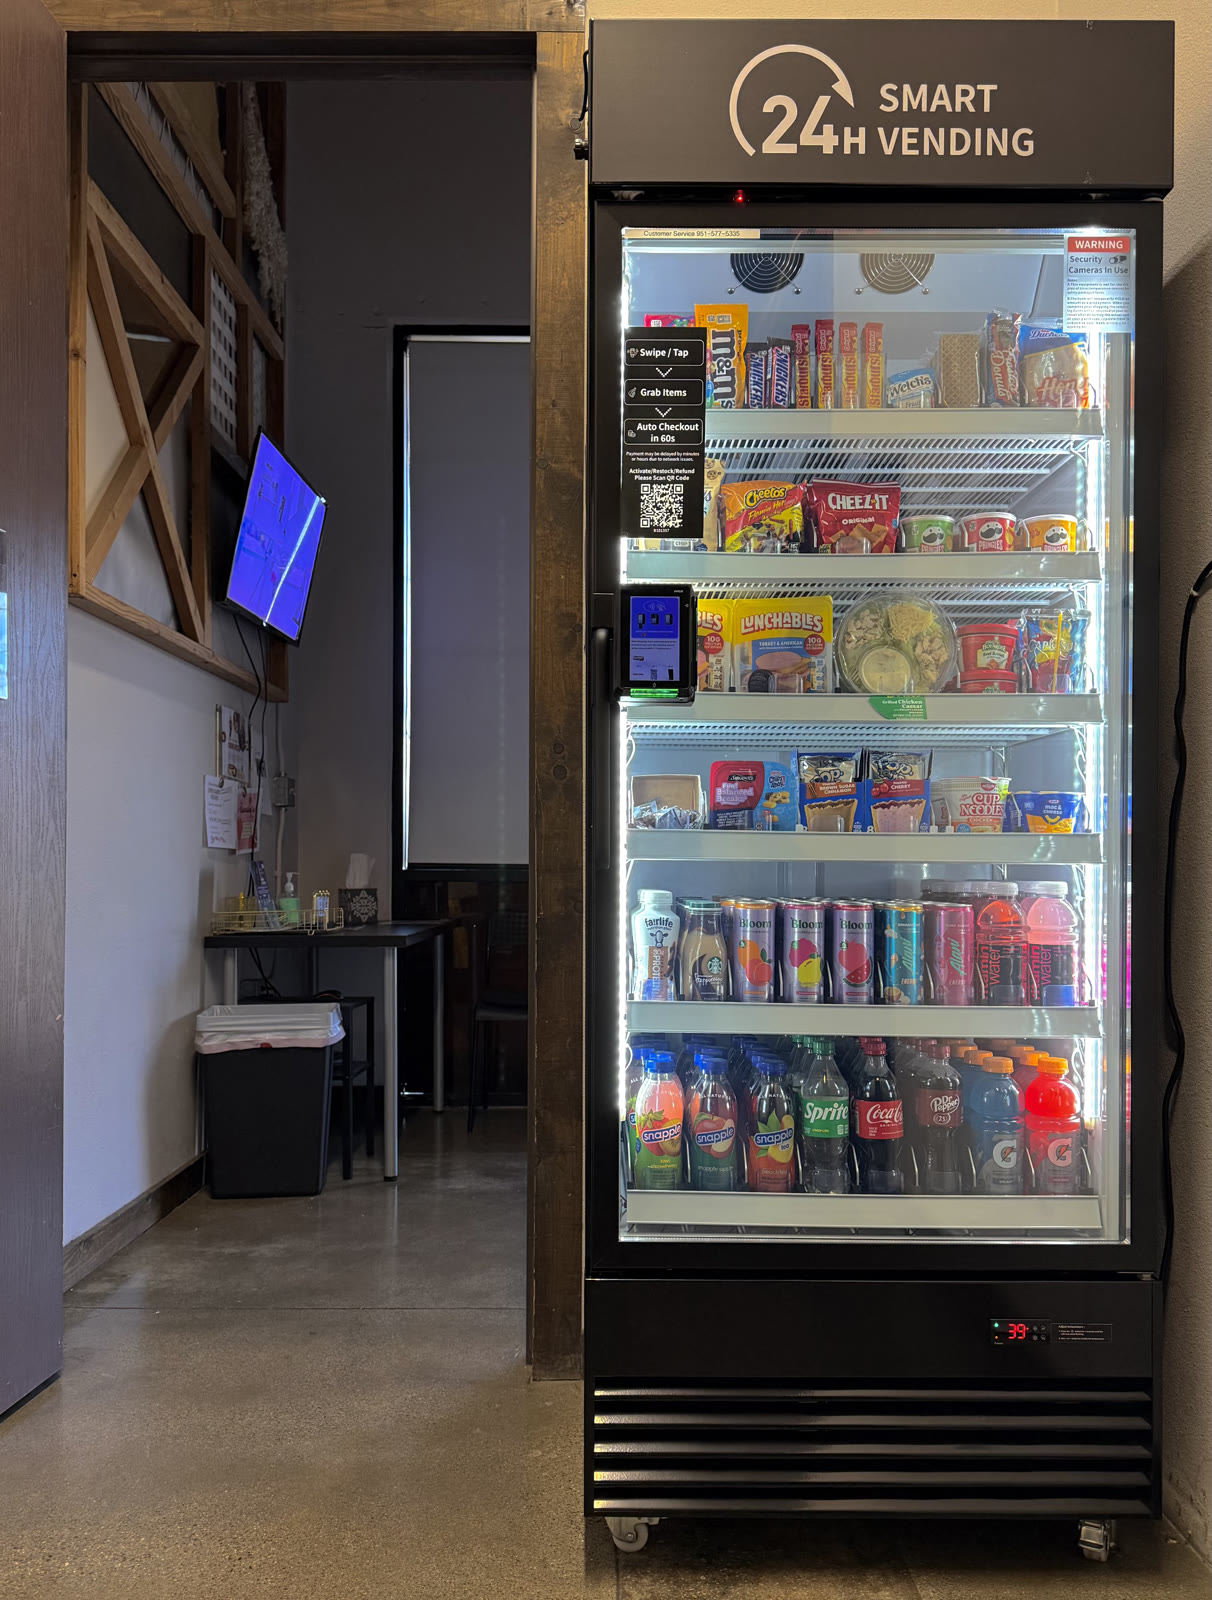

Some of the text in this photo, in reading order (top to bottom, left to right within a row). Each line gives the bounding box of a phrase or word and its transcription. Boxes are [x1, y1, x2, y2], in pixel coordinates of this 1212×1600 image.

[879, 83, 998, 112] SMART
[877, 127, 1035, 156] VENDING
[1075, 240, 1123, 249] WARNING
[1070, 256, 1102, 264] Security
[640, 348, 666, 358] Swipe
[673, 348, 688, 358] Tap
[750, 353, 764, 408] SNICKERS
[774, 347, 788, 406] SNICKERS
[640, 388, 687, 396] Grab Items
[890, 376, 932, 398] Welch's
[636, 422, 699, 430] Auto Checkout
[650, 434, 676, 442] in 60s
[746, 487, 786, 507] Cheetos
[978, 541, 1002, 550] PRINGLES
[740, 612, 823, 634] LUNCHABLES
[718, 787, 753, 795] Balanced
[972, 793, 1000, 805] CUP
[960, 804, 1004, 816] NOODLES
[644, 917, 673, 928] fairlife
[740, 918, 772, 928] Bloom
[791, 919, 822, 929] Bloom
[840, 920, 873, 930] Bloom
[989, 946, 1000, 985] water
[1040, 946, 1051, 985] water
[931, 1097, 958, 1112] Pepper
[942, 1096, 952, 1104] Dr
[804, 1102, 848, 1123] Sprite
[644, 1124, 681, 1142] snapple
[697, 1128, 734, 1144] snapple
[756, 1129, 793, 1145] snapple
[993, 1139, 1016, 1169] G
[1048, 1138, 1072, 1167] G
[1008, 1324, 1025, 1339] 39
